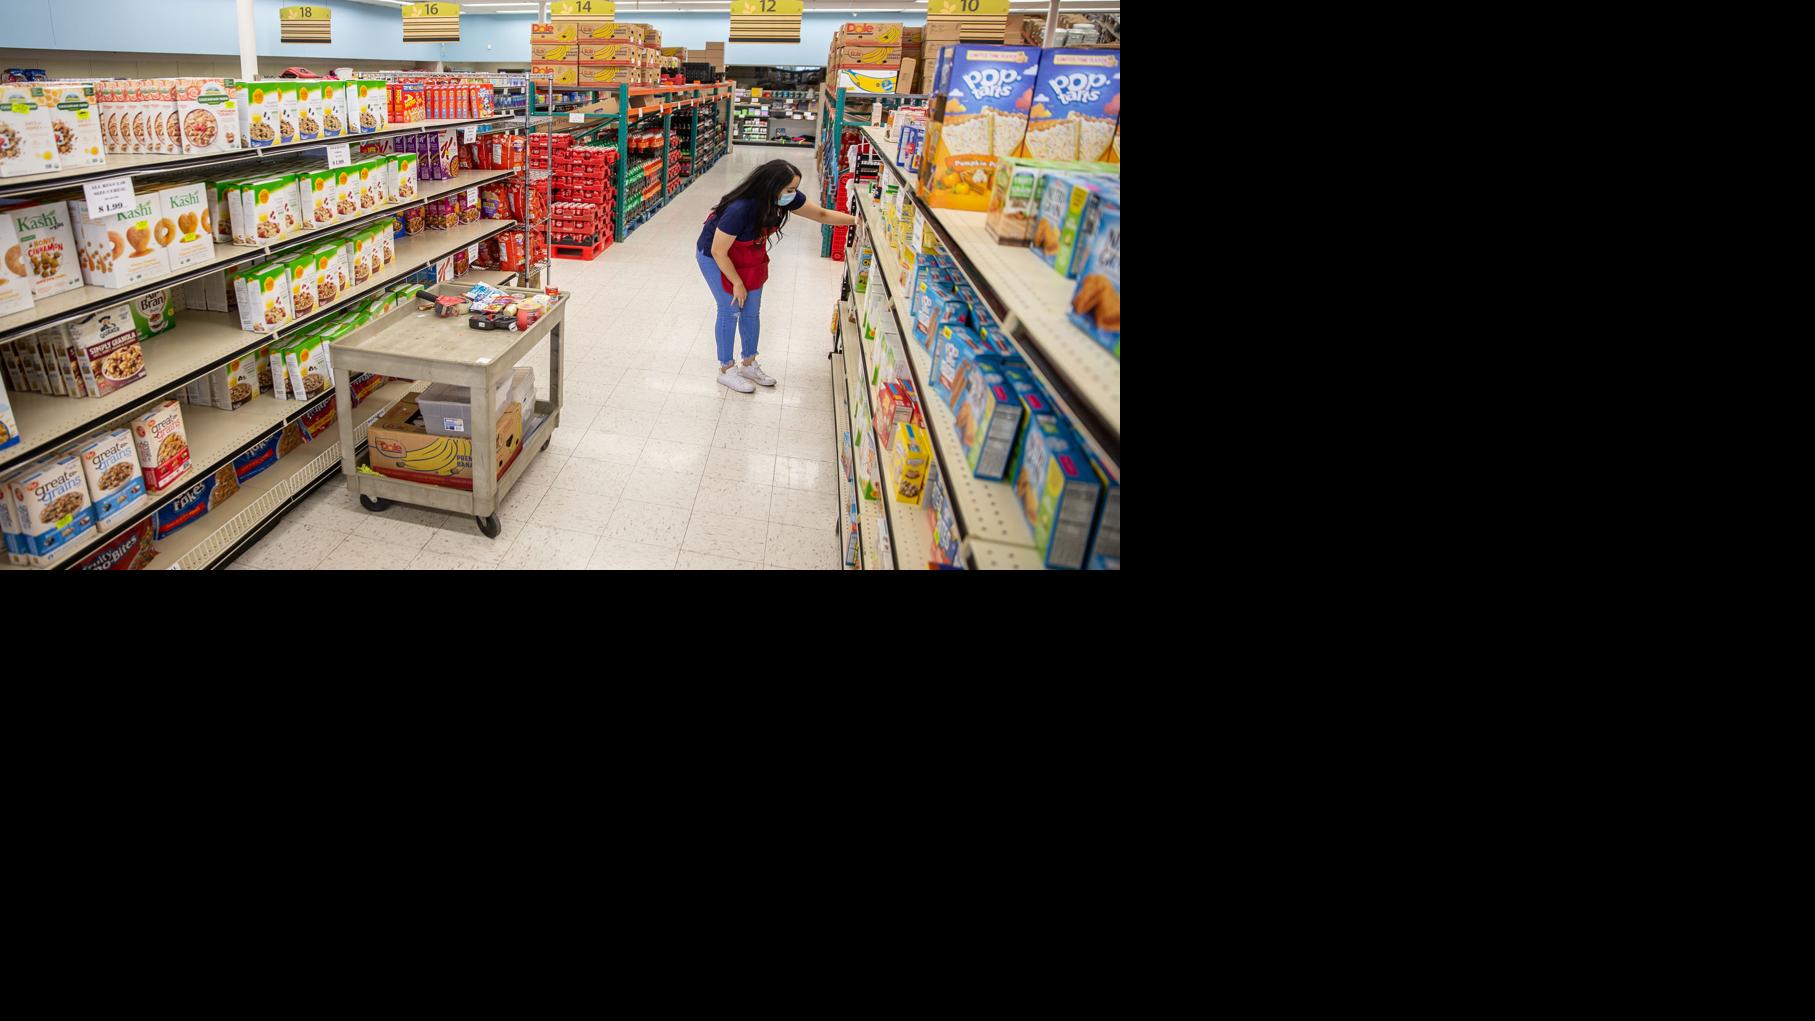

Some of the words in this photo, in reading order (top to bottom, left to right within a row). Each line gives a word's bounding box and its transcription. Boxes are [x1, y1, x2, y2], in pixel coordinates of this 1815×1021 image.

[299, 6, 312, 18] 18
[424, 3, 439, 15] 16
[575, 0, 592, 12] 14
[760, 0, 777, 12] 12
[961, 0, 980, 12] 10
[531, 23, 554, 32] Dole
[847, 23, 874, 33] Dole
[170, 191, 200, 209] Kashi
[17, 210, 58, 233] Kashi
[140, 296, 164, 311] Bran
[151, 415, 175, 439] great
[157, 418, 181, 442] grains
[379, 440, 403, 453] Dole
[92, 443, 120, 470] great
[101, 447, 132, 474] grains
[35, 472, 70, 502] great
[45, 475, 82, 506] grains
